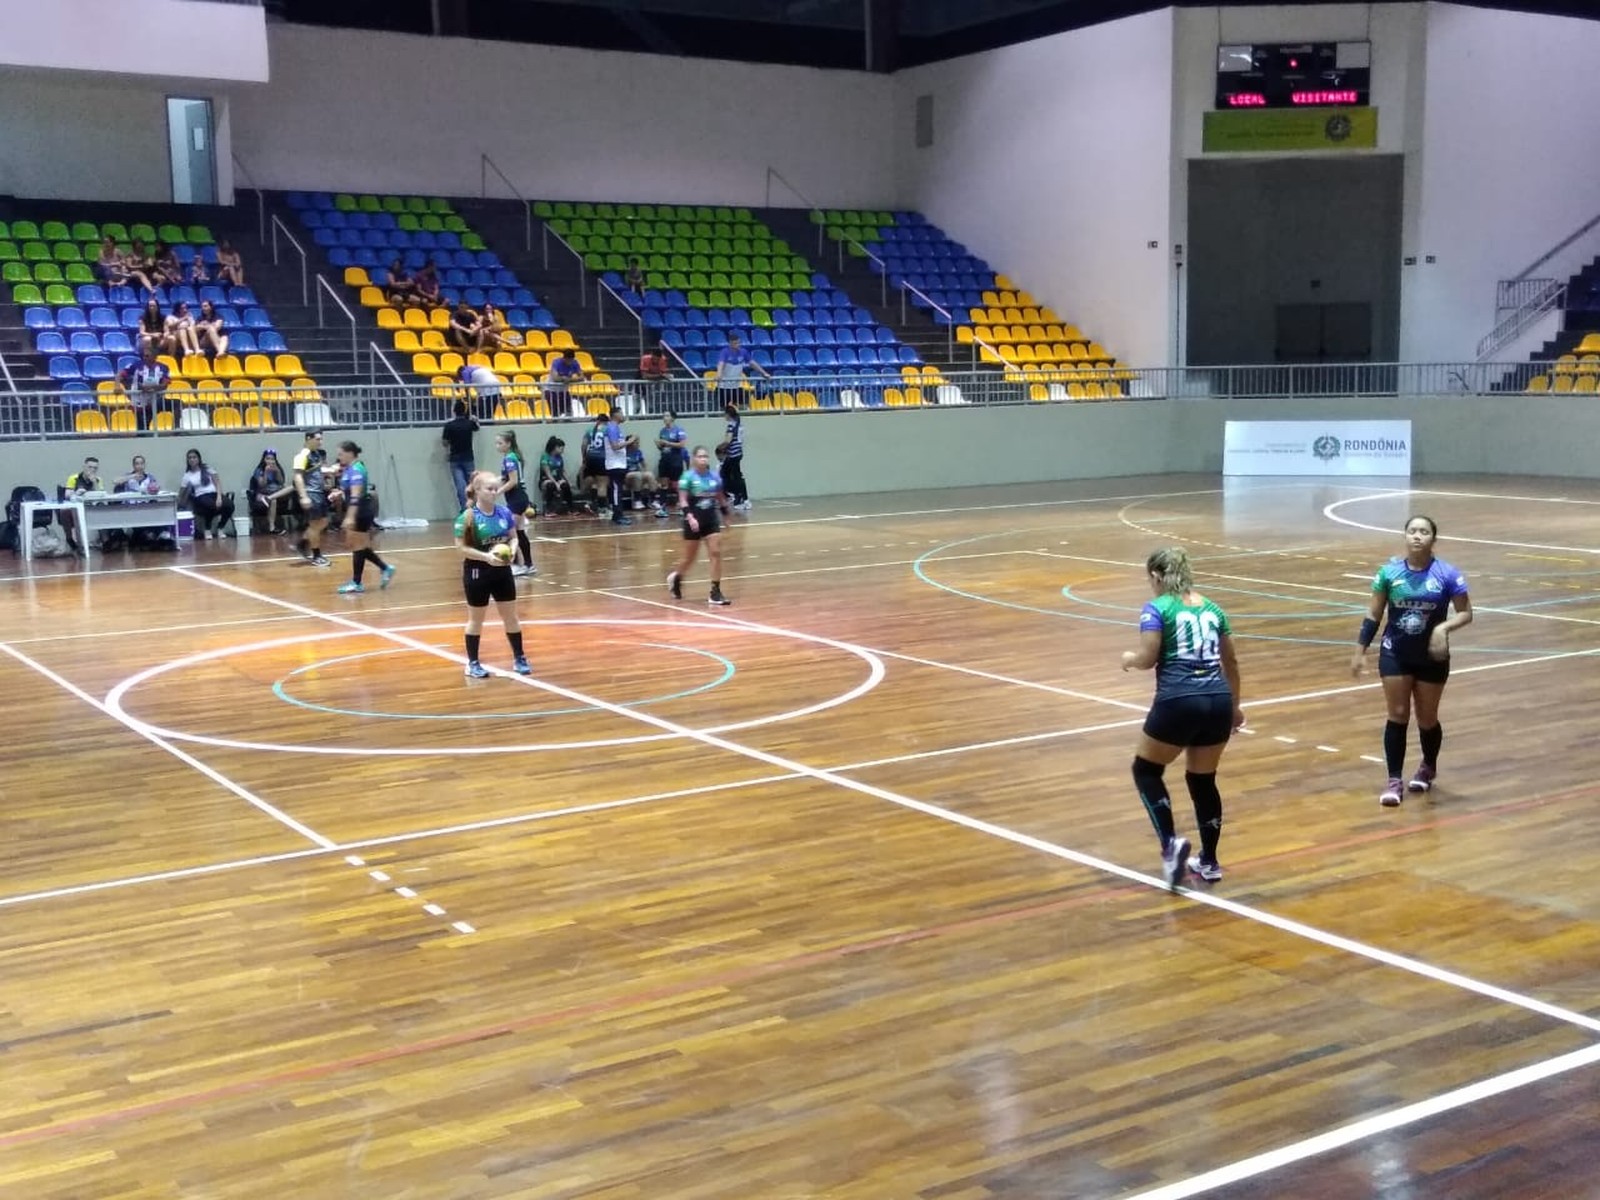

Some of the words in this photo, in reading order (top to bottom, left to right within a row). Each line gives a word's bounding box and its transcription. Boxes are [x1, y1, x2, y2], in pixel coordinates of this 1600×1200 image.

[1229, 93, 1267, 106] LOCAL
[1291, 90, 1358, 104] VISITANTE
[1344, 437, 1407, 451] RONDÔNIA
[1175, 610, 1221, 661] 06
